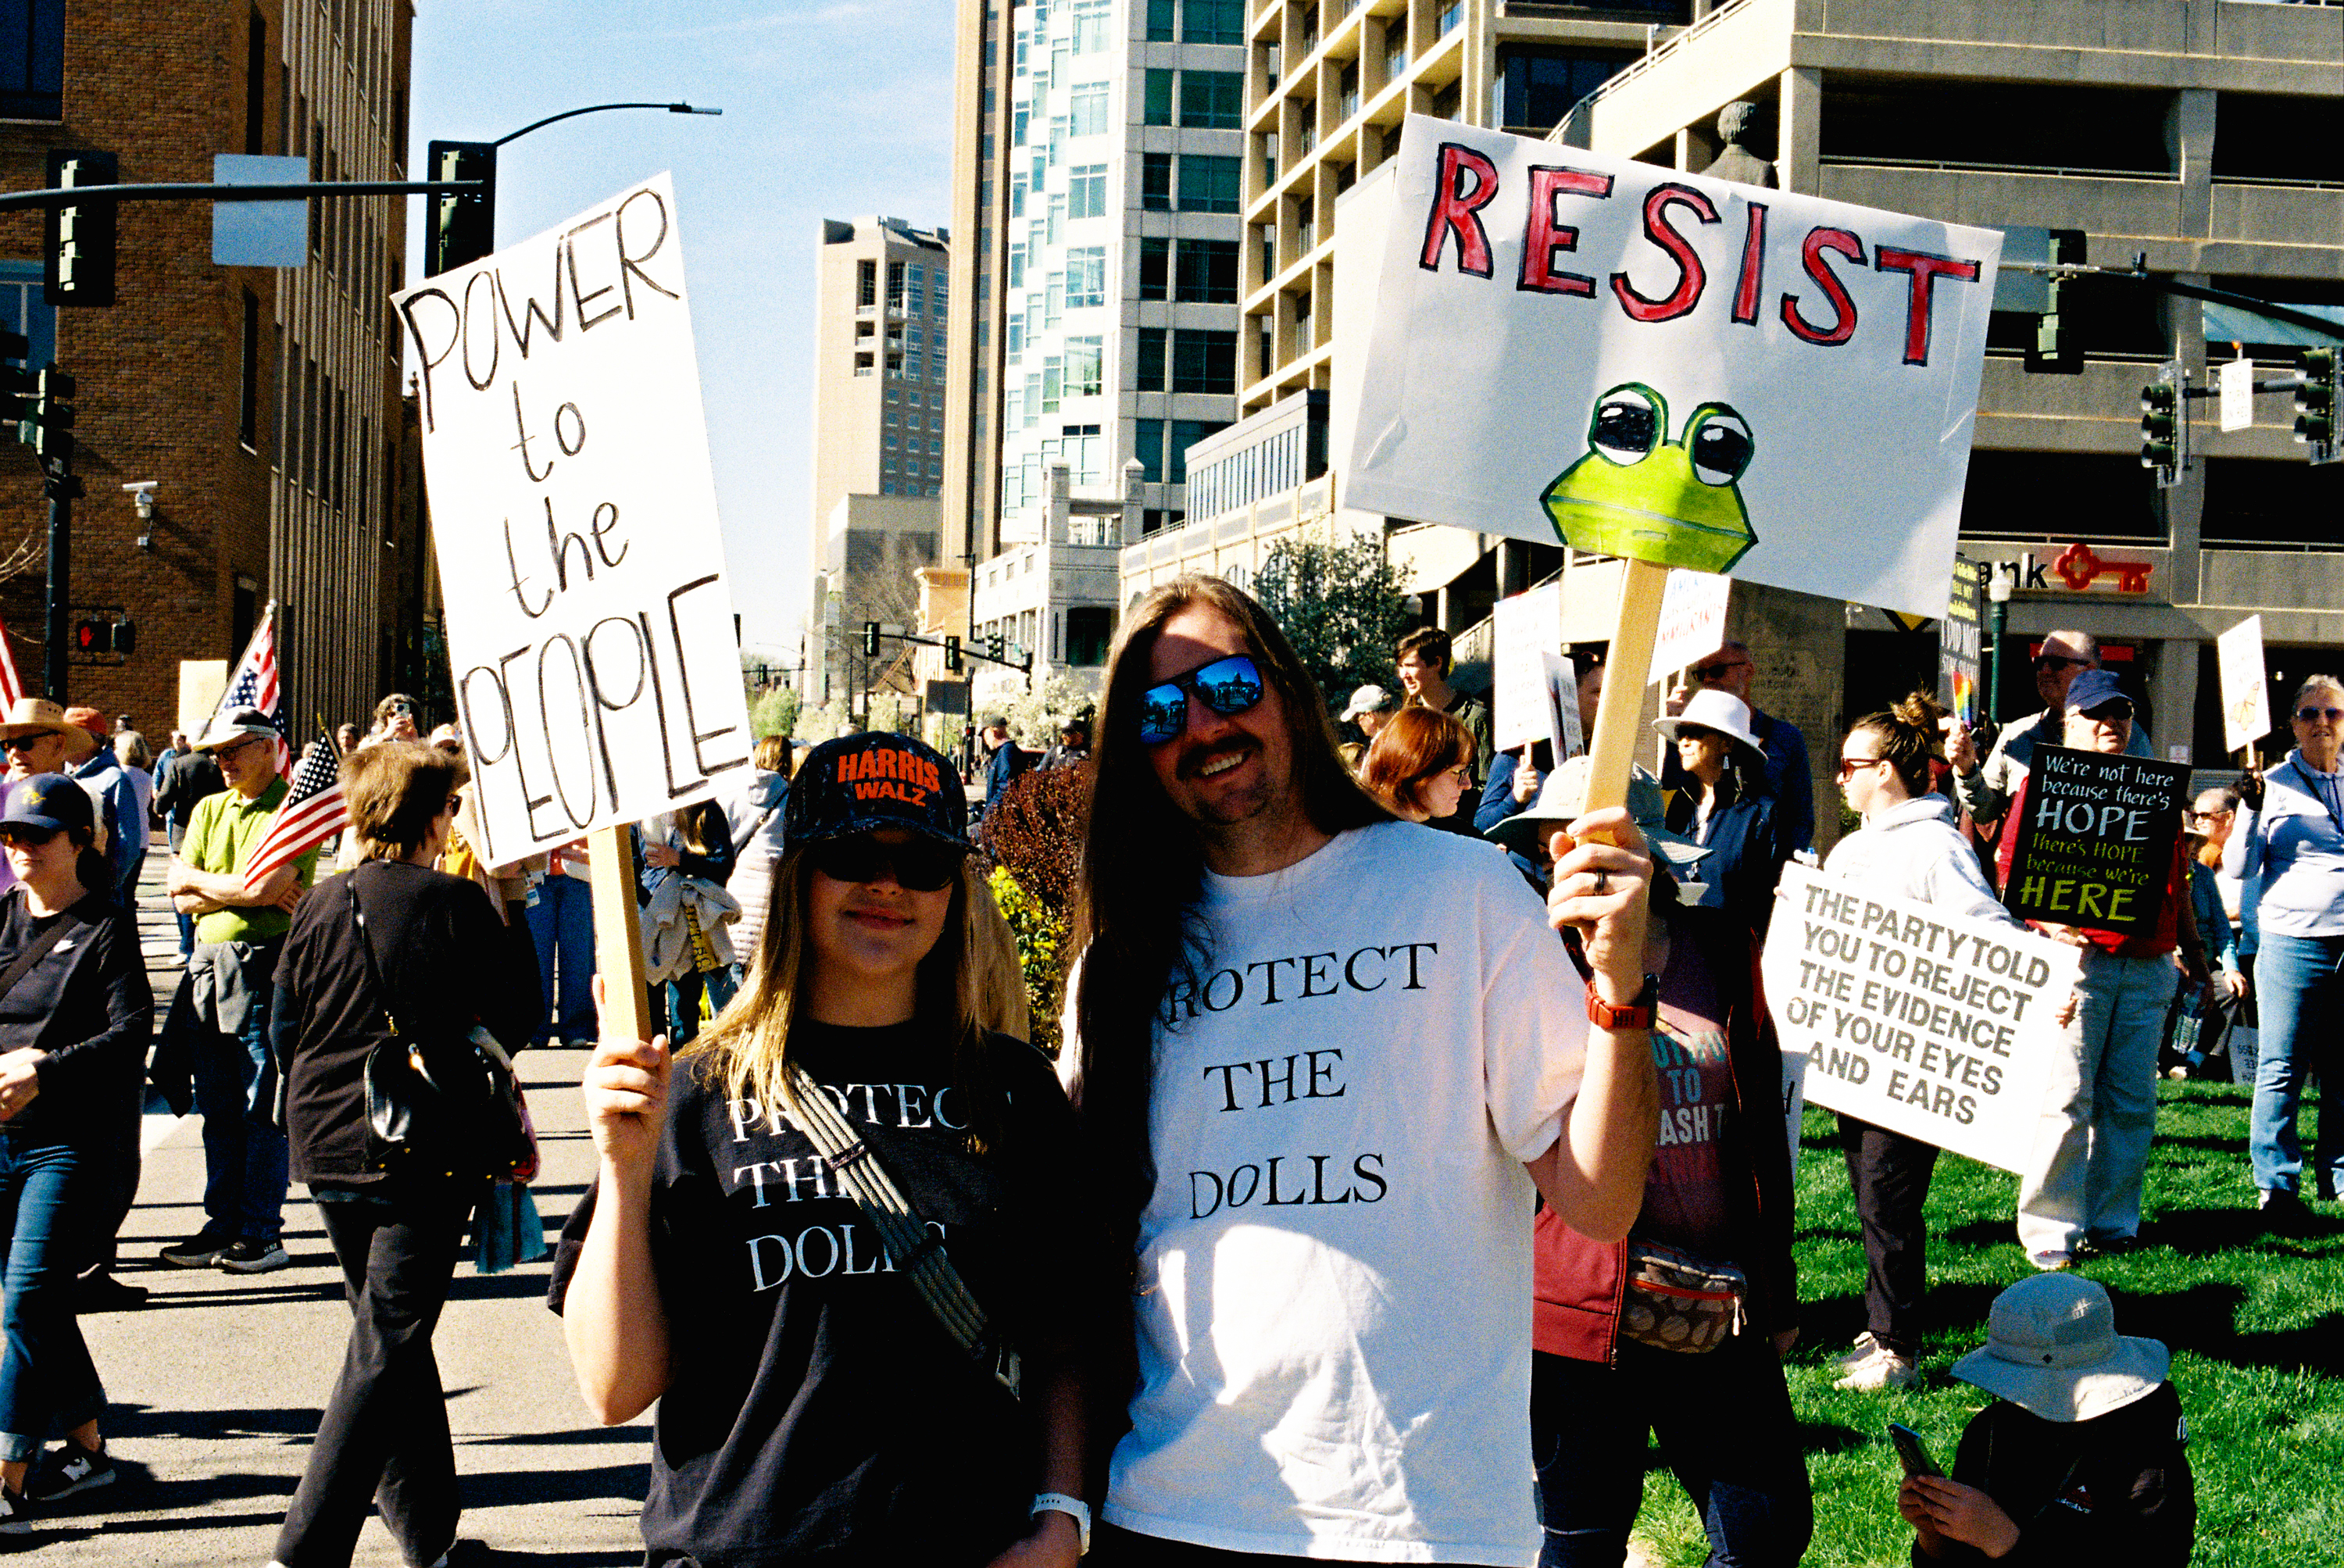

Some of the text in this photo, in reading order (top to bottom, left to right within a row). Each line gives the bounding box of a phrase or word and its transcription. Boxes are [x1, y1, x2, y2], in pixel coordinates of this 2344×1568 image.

[1418, 141, 1981, 366] RESIST
[400, 188, 681, 434] POWER
[509, 380, 586, 484] to
[504, 495, 630, 620] the
[457, 573, 749, 860] PEOPLE
[838, 748, 941, 792] HARRIS
[855, 781, 927, 807] WALZ
[2042, 774, 2170, 810] because there's
[2046, 755, 2174, 787] We're not here
[2031, 832, 2145, 863] There's HOPE
[2035, 798, 2150, 841] HOPE
[2019, 875, 2136, 922] HERE
[2026, 853, 2149, 886] because we're
[1804, 883, 2050, 988] THE PARTY TOLD
[1163, 942, 1438, 1025] ROTECT
[1803, 920, 2033, 1023] YOU TO REJECT
[1799, 959, 2016, 1058] THE EVIDENCE
[1786, 996, 2003, 1095] OF YOUR EYES
[1203, 1048, 1346, 1112] THE
[1667, 1068, 1702, 1105] TO
[1805, 1041, 1978, 1125] AND EARS
[733, 1155, 853, 1209] TH
[1188, 1153, 1388, 1220] DOLLS
